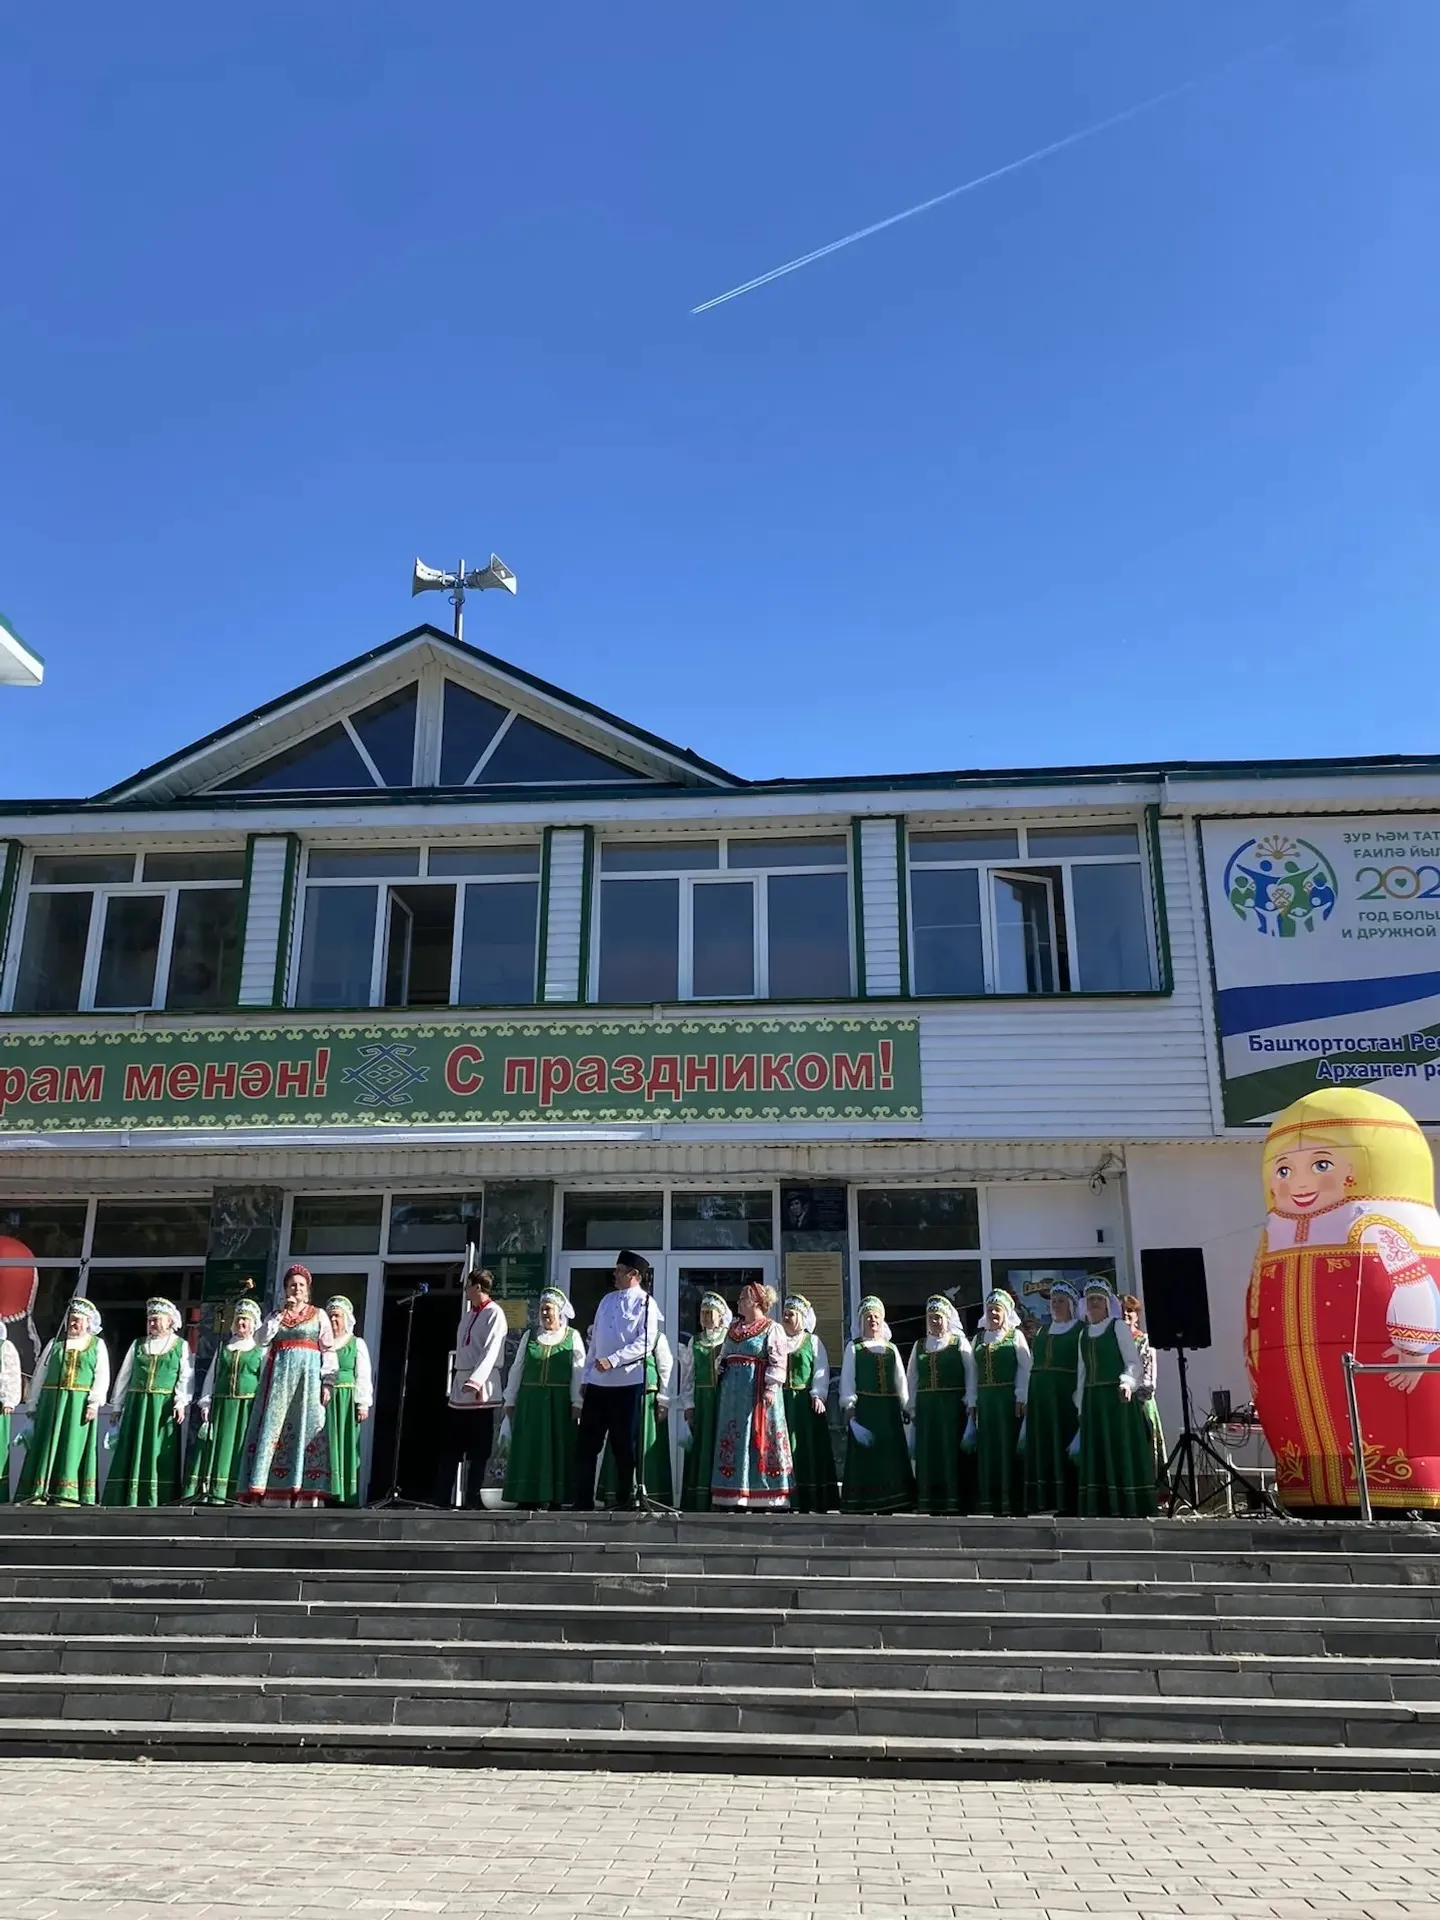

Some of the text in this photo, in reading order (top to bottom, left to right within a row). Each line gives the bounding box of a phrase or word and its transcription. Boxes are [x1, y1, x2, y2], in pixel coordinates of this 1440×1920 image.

[1412, 831, 1440, 841] ТАТ
[1355, 866, 1440, 900] 202
[1359, 911, 1389, 922] ГОД
[1342, 925, 1436, 940] И ДРУЖНОЙ
[1249, 1035, 1402, 1054] Башҡортостан
[123, 1047, 331, 1102] менән!
[445, 1040, 894, 1107] С праздником!
[1317, 1060, 1417, 1081] Архангел
